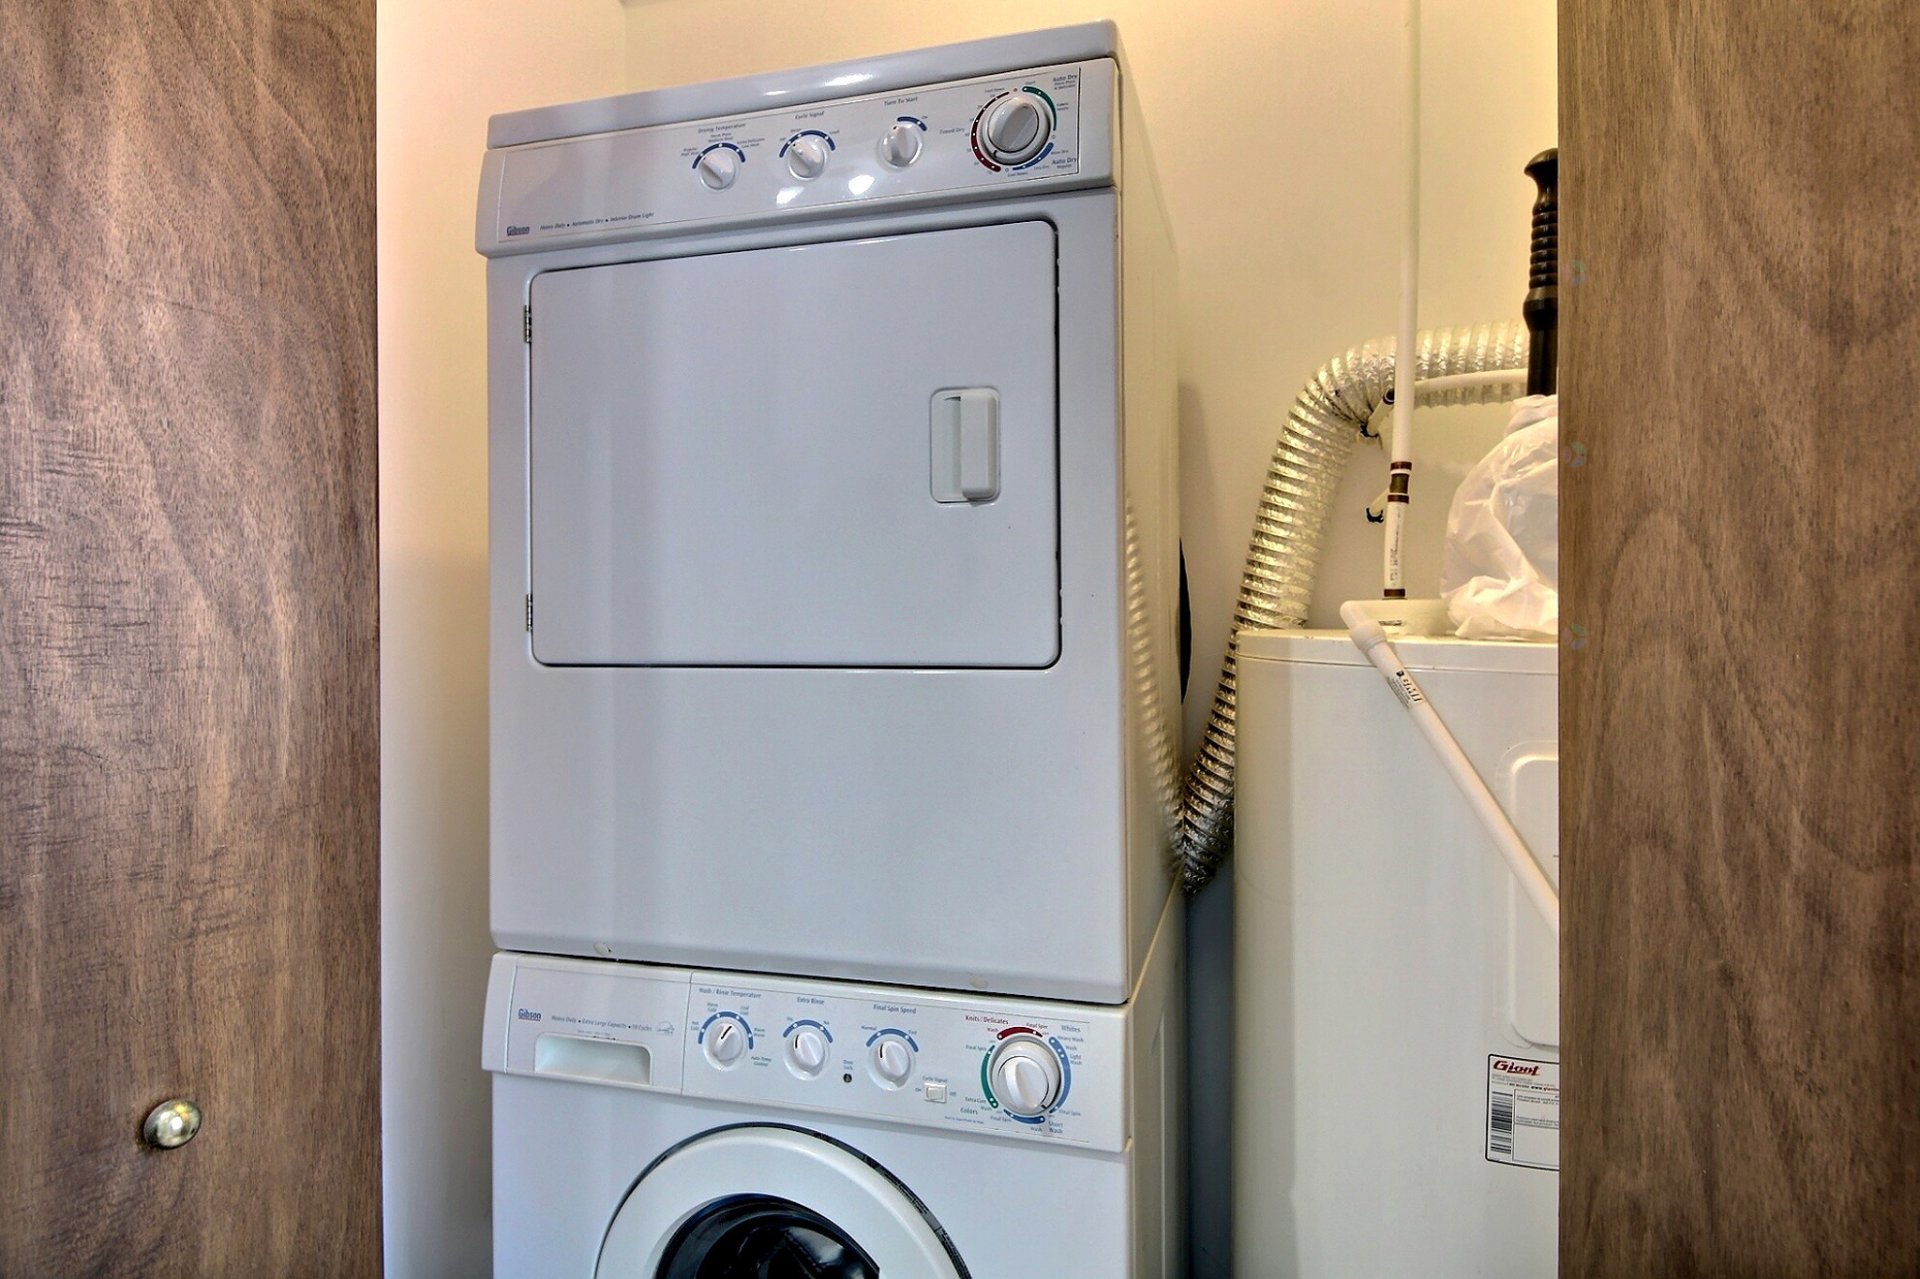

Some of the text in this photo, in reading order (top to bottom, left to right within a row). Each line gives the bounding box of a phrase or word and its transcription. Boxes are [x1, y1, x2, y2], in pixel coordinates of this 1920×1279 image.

[715, 123, 746, 132] Temperature
[507, 225, 530, 236] Gibson
[730, 990, 762, 998] Temperature
[887, 1005, 899, 1013] Spin
[900, 1006, 917, 1014] Speed
[518, 1008, 541, 1021] Gibson
[983, 1017, 1009, 1025] Delicates
[1061, 1025, 1081, 1033] Whites
[1493, 1060, 1540, 1076] Giant
[960, 1107, 978, 1116] Colors
